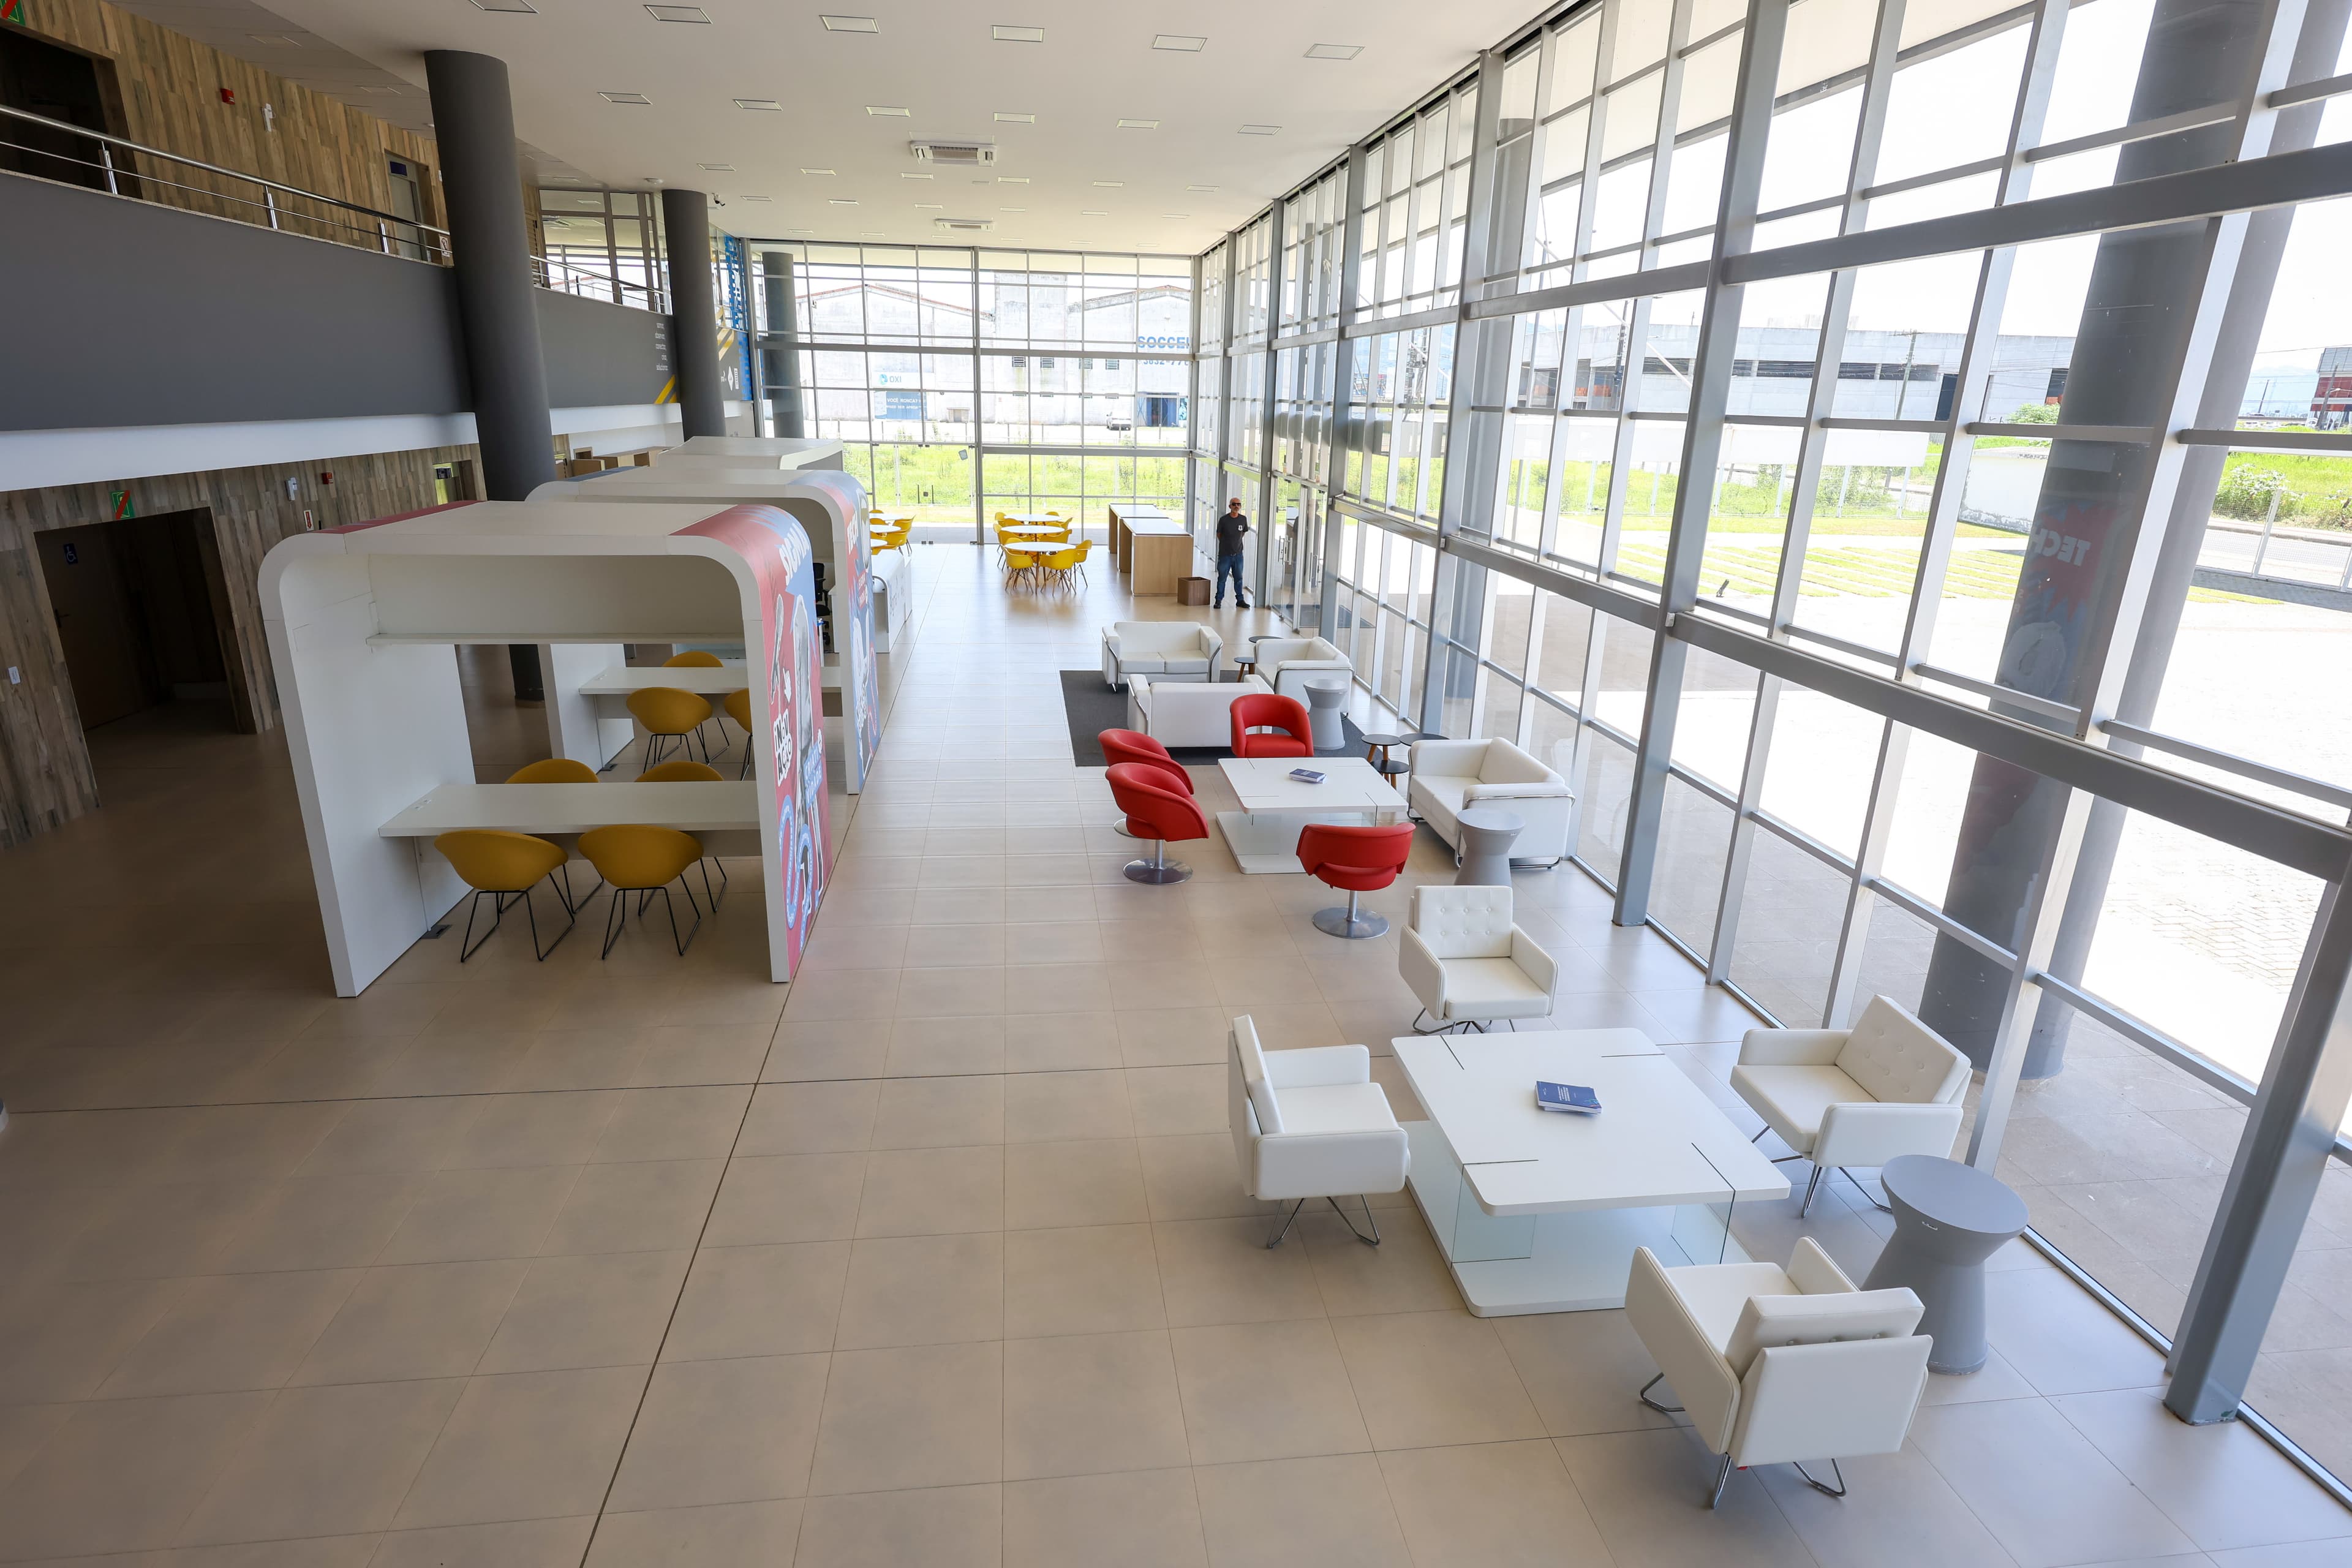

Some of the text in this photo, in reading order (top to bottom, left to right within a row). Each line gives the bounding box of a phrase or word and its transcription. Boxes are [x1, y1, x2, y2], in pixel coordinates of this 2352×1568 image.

[778, 522, 810, 586] SIGMA
[847, 510, 859, 555] TECH
[777, 738, 792, 781] AÇÃO
[805, 766, 822, 804] VIDADE
